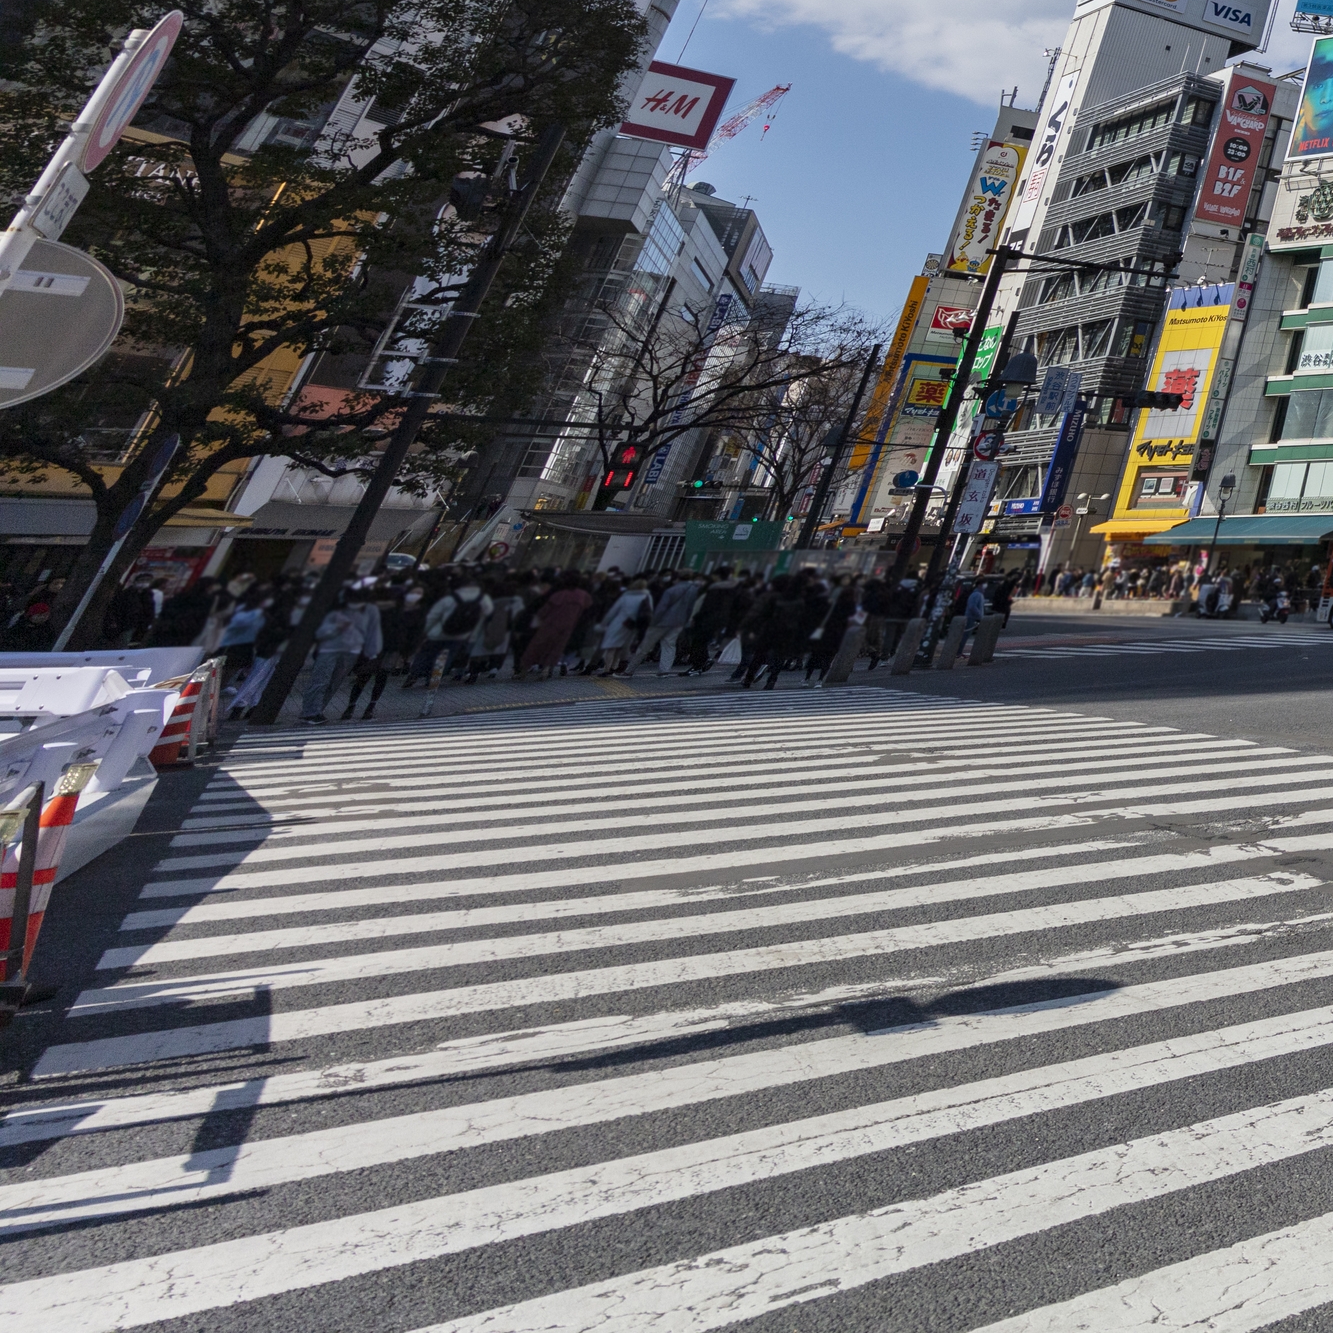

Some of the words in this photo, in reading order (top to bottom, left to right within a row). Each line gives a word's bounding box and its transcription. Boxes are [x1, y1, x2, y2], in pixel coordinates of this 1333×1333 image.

[1210, 0, 1251, 27] VISA
[641, 88, 700, 120] H&M
[1298, 137, 1330, 152] NETFLIX
[1218, 165, 1245, 182] B1F
[1213, 181, 1242, 198] B2F
[1168, 316, 1208, 326] Matsumoto
[916, 381, 945, 403] 薬
[1044, 370, 1065, 412] 渋谷駅前
[958, 468, 987, 527] 道玄坂
